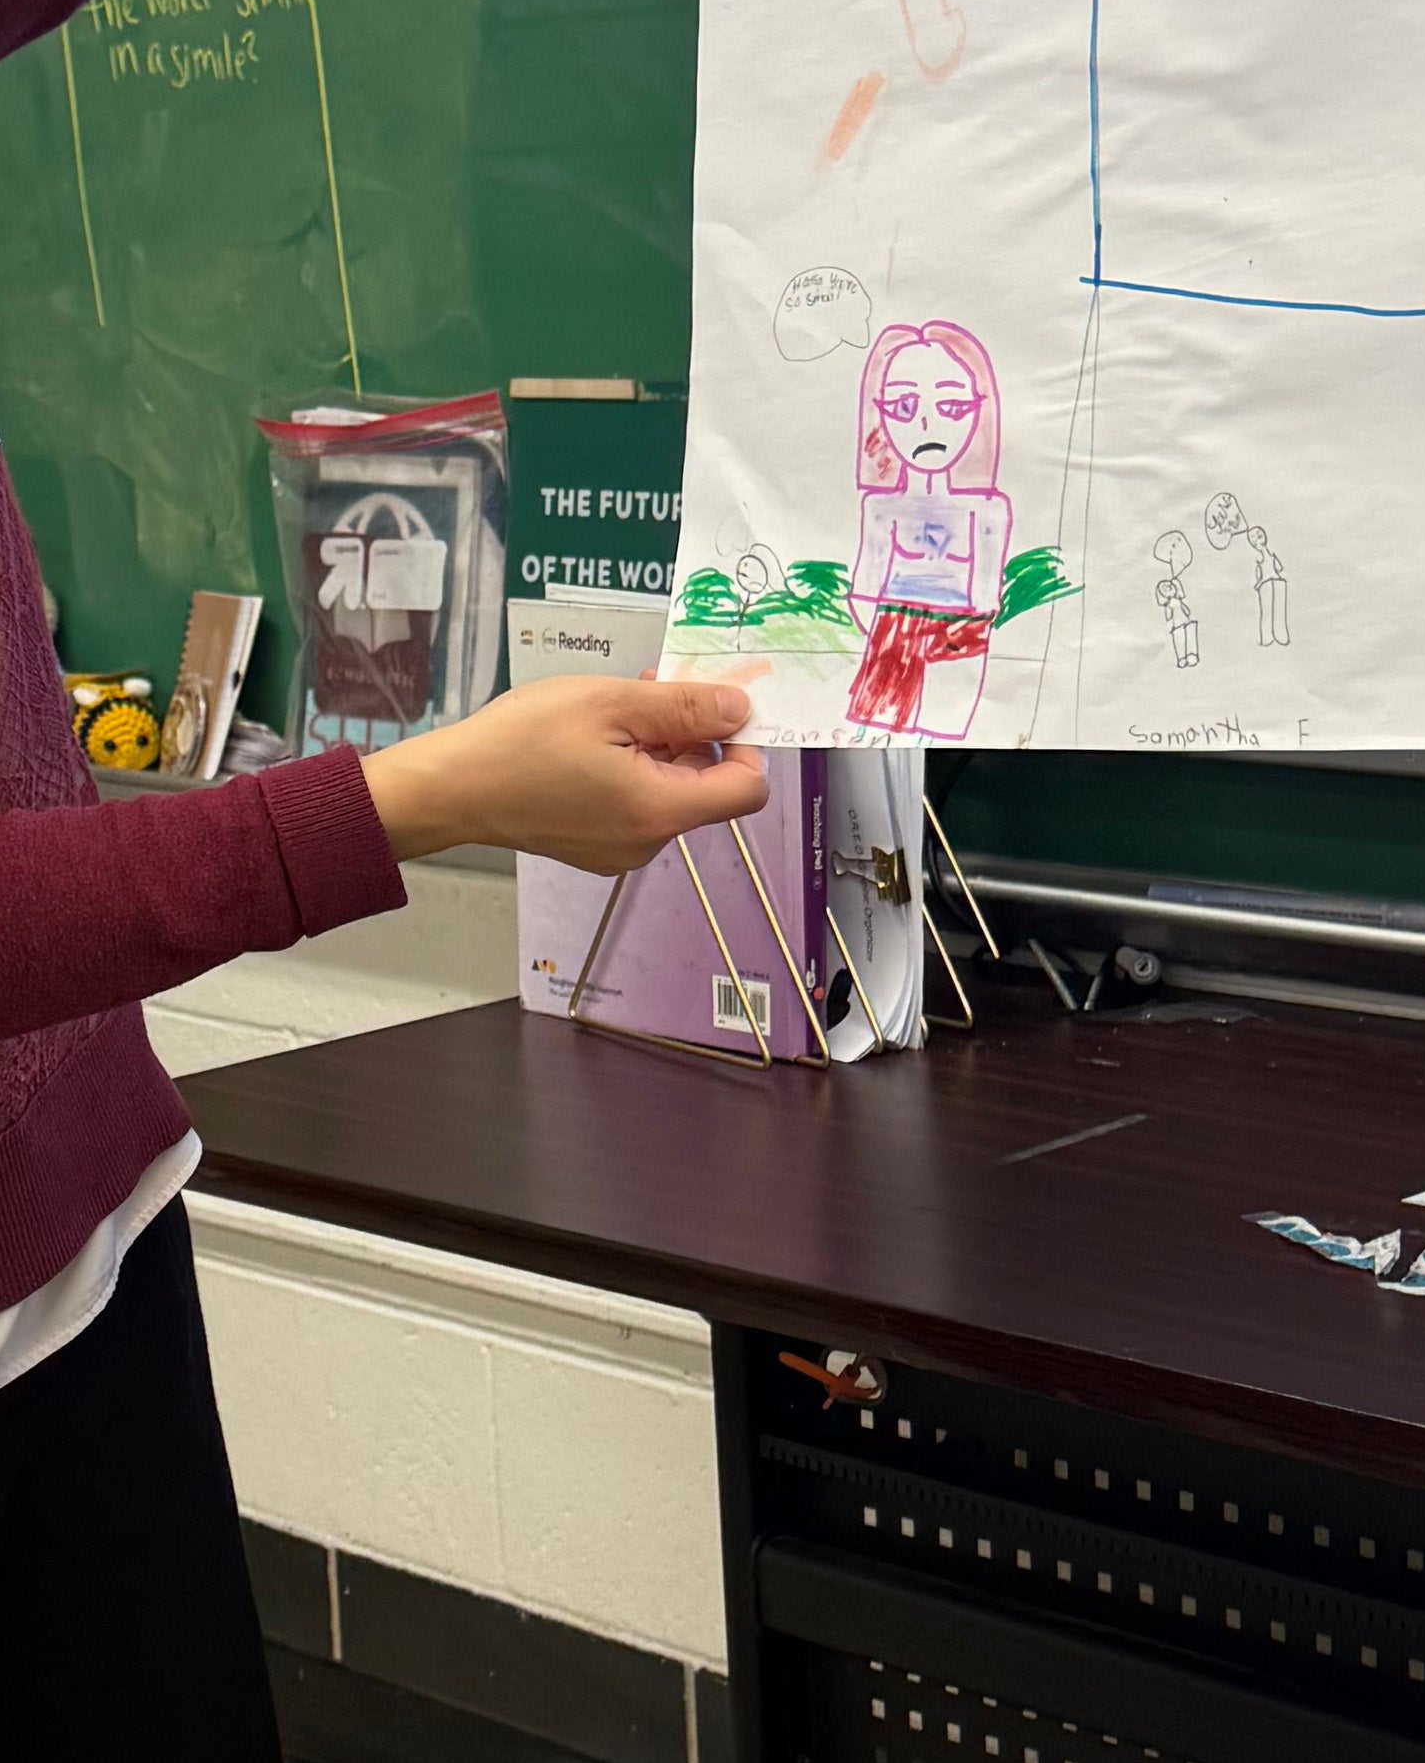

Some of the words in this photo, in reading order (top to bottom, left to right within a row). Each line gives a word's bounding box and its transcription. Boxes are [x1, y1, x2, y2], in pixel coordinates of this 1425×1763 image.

[147, 42, 165, 75] a
[541, 486, 591, 518] THE
[521, 555, 556, 583] OF
[562, 557, 613, 588] THE
[558, 630, 611, 656] Reading
[1298, 719, 1309, 745] F
